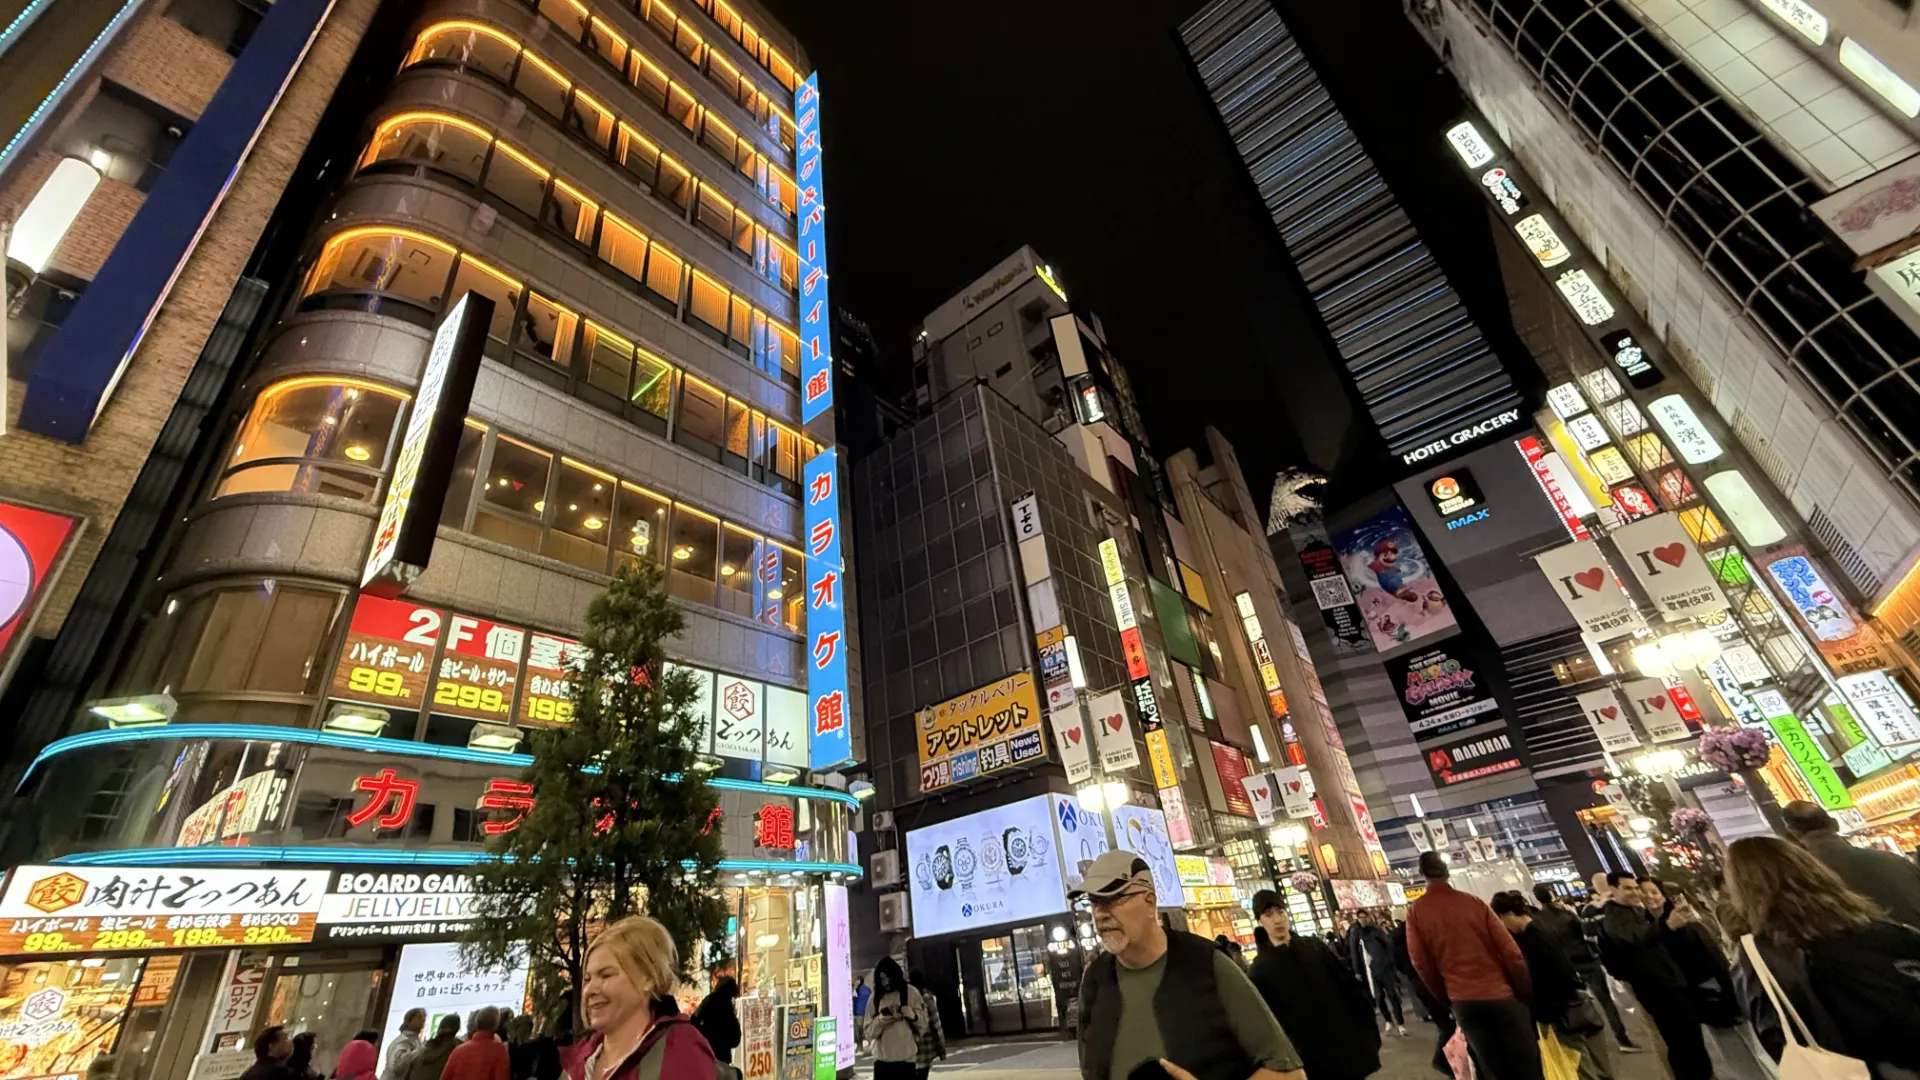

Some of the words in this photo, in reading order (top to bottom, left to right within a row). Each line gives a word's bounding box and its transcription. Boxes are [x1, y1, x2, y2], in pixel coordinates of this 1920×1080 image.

[799, 86, 829, 403] カラオケ&パーティー館
[1403, 440, 1452, 466] HOTEL
[1449, 409, 1521, 446] GRACERY
[1438, 495, 1464, 510] TOHO
[1447, 508, 1489, 531] IMAX
[1637, 551, 1661, 576] I
[1559, 576, 1583, 601] I
[1661, 585, 1712, 602] KABUKI-CHO
[810, 471, 844, 737] カラオケ館
[1666, 593, 1716, 612] 歌舞伎町
[1585, 607, 1629, 625] KABUKI-CHO
[1589, 613, 1634, 634] 歌舞伎町
[349, 642, 424, 673] ハイボール
[440, 657, 515, 687] 生ビール・サワー
[726, 686, 752, 716] 餃
[949, 678, 1028, 718] タックルベリー
[1428, 691, 1461, 706] MOVIE
[1850, 686, 1891, 699] ルノアール
[1591, 709, 1605, 725] I
[1637, 699, 1652, 715] I
[927, 702, 1029, 758] アウトレット
[1099, 718, 1110, 737] I
[1010, 733, 1040, 750] New&
[1060, 731, 1071, 750] I
[1452, 734, 1512, 763] MARUHAN
[980, 742, 1010, 771] 釣具
[1014, 744, 1041, 760] Used
[923, 761, 951, 789] つり具
[951, 755, 979, 780] Fishing
[1079, 810, 1124, 830] OKA
[84, 874, 313, 909] 肉汁とっつあん
[337, 874, 421, 893] BOARD
[973, 900, 1004, 913] OKURA
[10, 917, 88, 933] ハイボール
[98, 916, 155, 930] 生ビール
[416, 983, 506, 998] 自由に遊べるカフェ
[223, 986, 242, 1031] ロッカー
[238, 985, 259, 1021] コイン
[750, 1051, 772, 1078] 250
